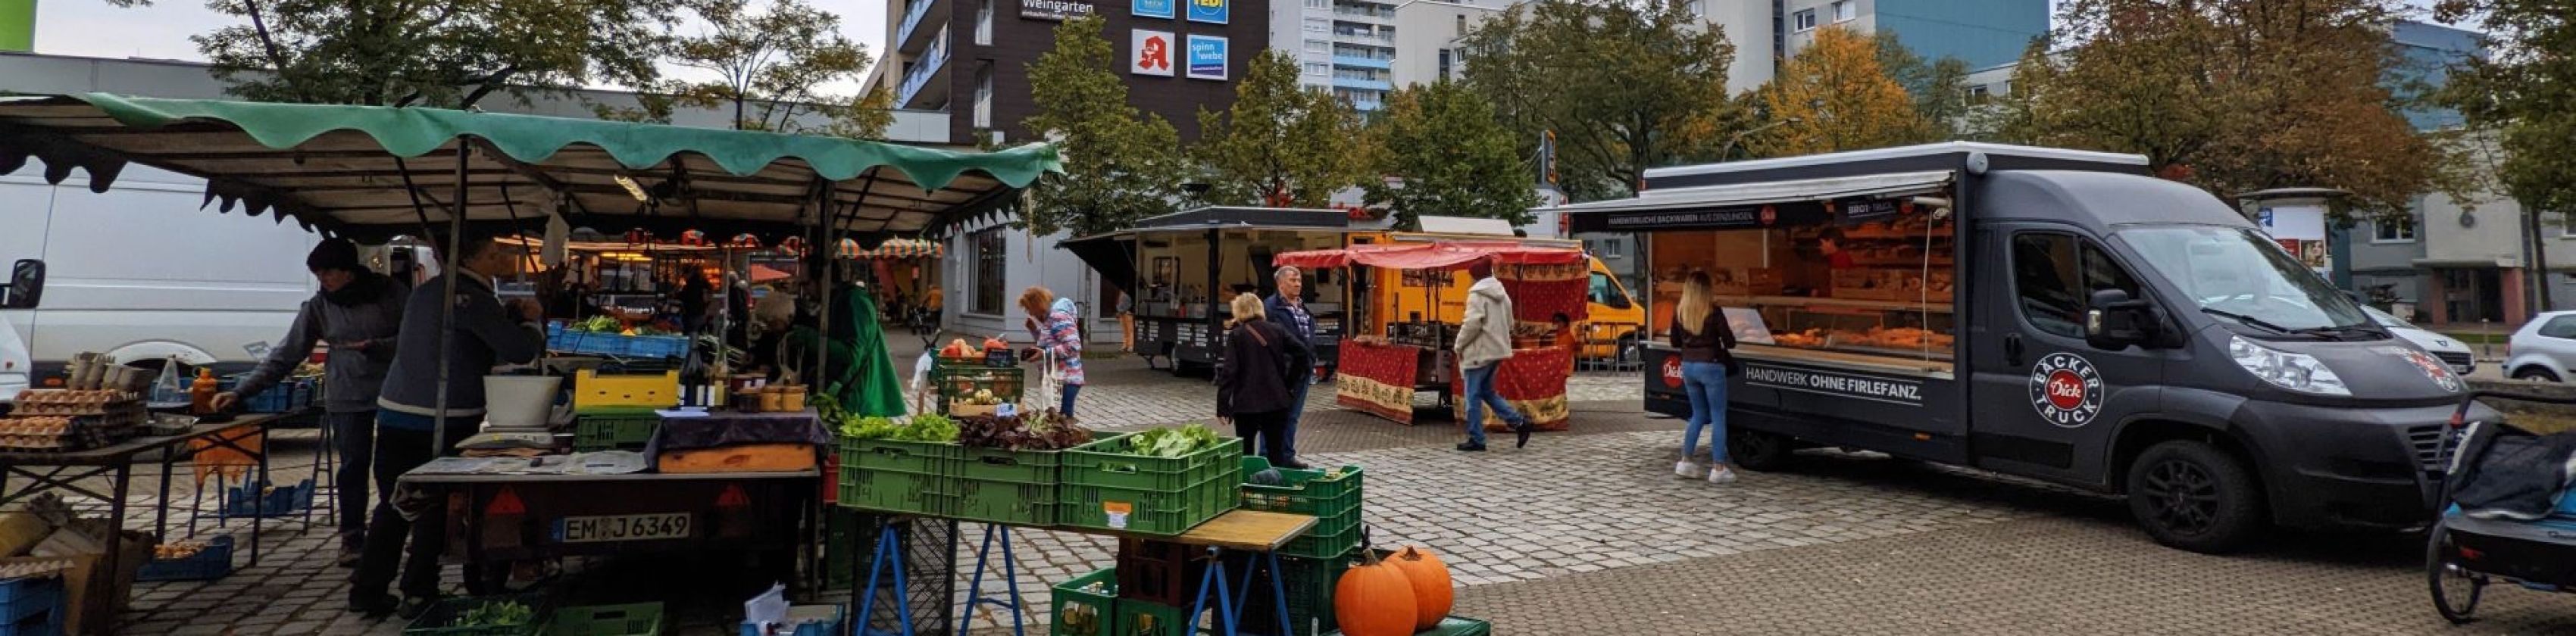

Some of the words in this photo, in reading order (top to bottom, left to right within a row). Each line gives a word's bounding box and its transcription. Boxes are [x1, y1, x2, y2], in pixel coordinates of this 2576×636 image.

[1023, 0, 1093, 13] Weingarten
[1192, 42, 1215, 52] spinn
[1746, 366, 1808, 386] HANDWERK
[1810, 375, 1846, 391] OHNE
[1847, 379, 1922, 401] FIRLEFANZ.
[2034, 356, 2099, 388] BÄCKER
[2050, 379, 2082, 398] Dick
[2036, 394, 2098, 423] TRUCK
[566, 519, 596, 540] EM
[631, 516, 687, 537] 6349
